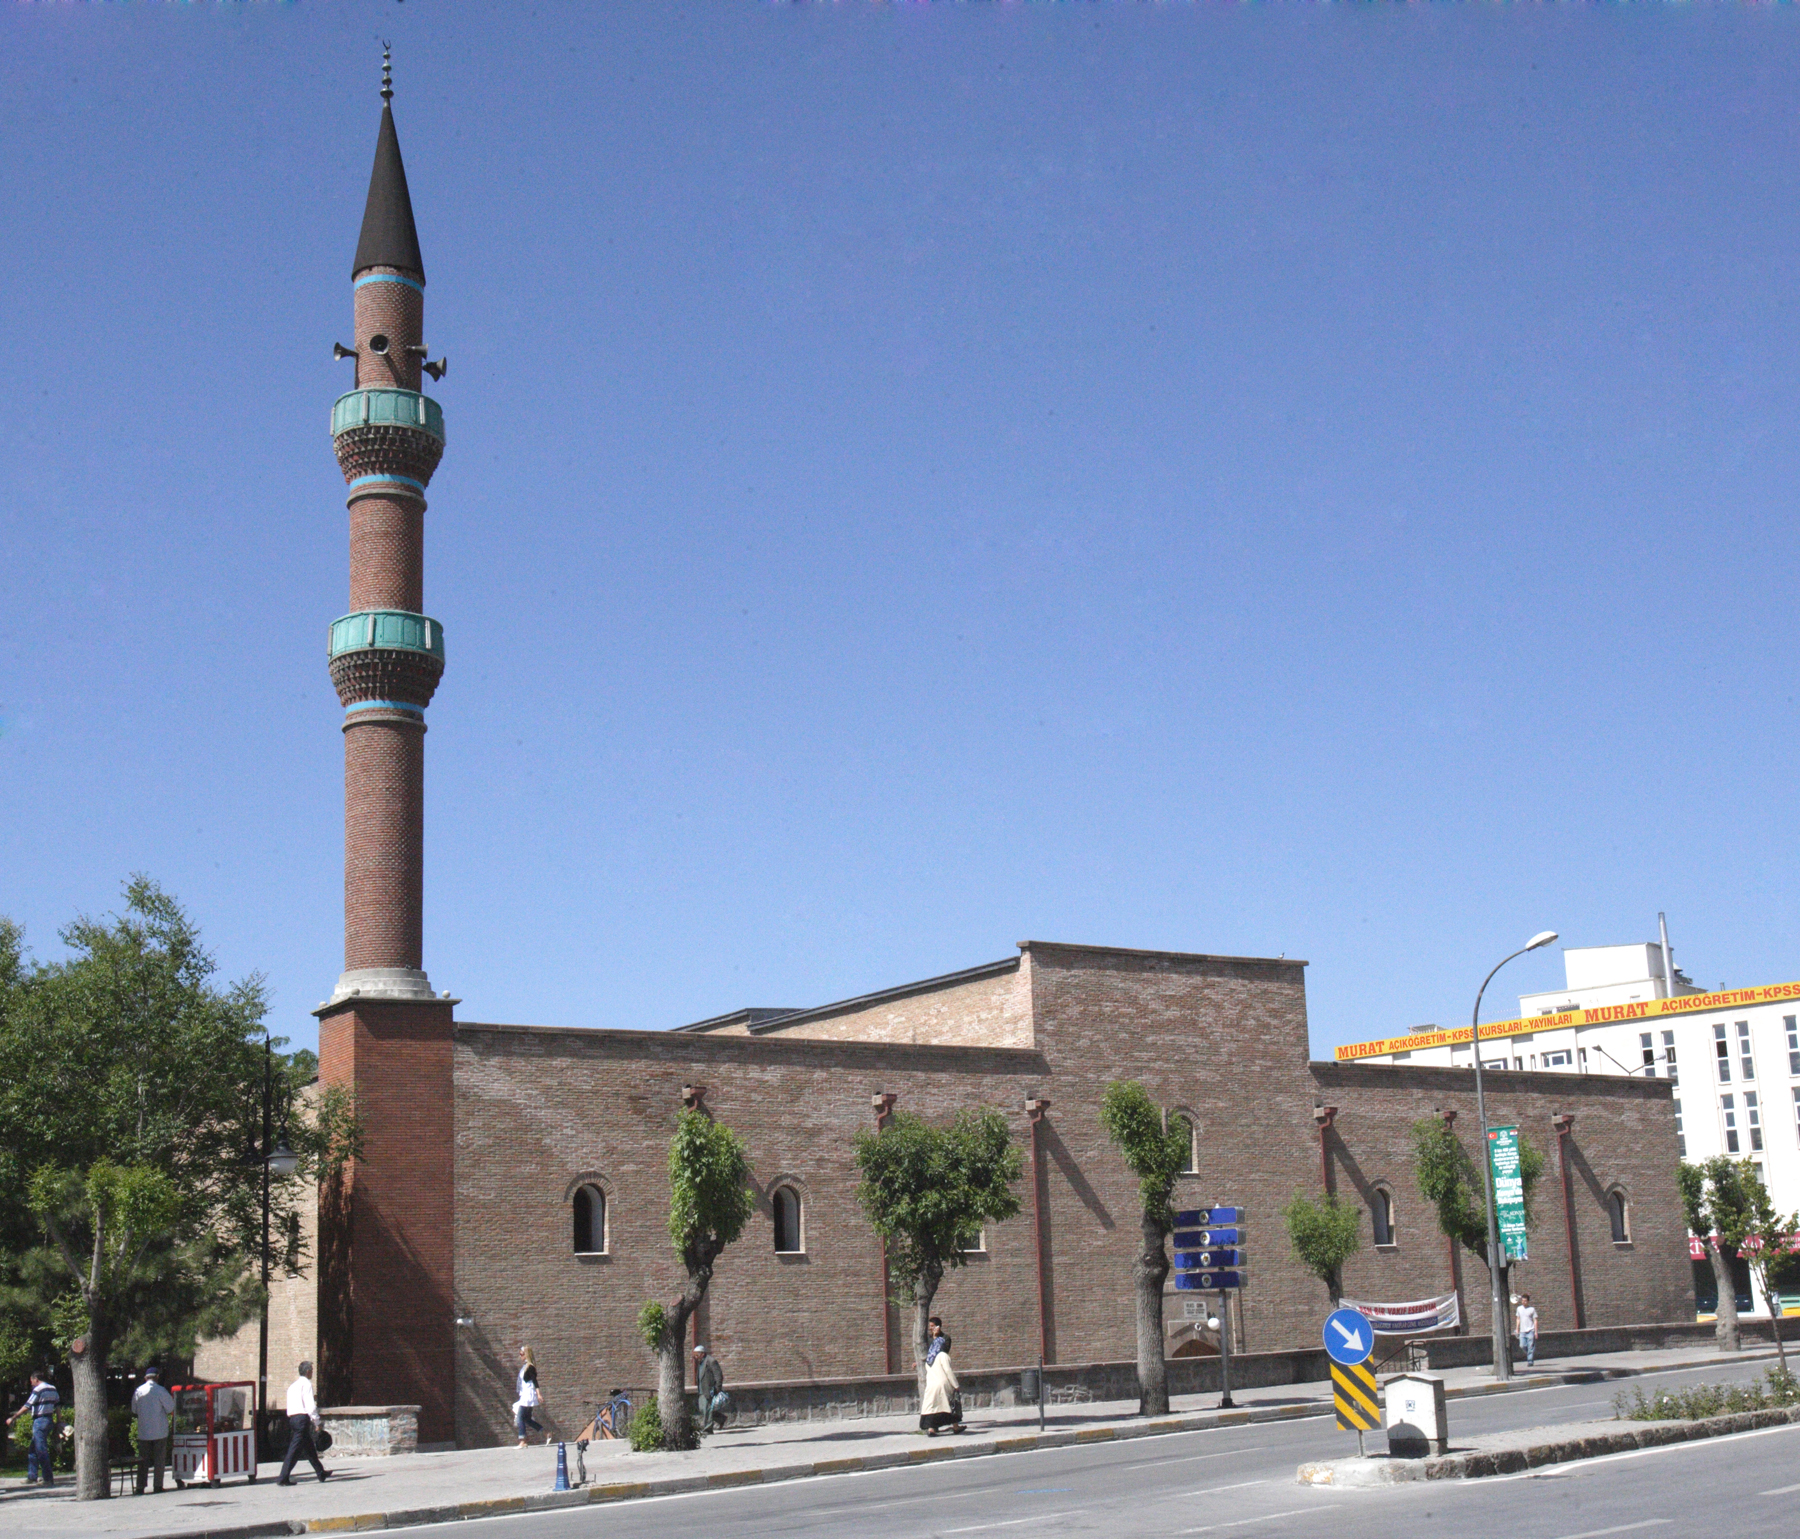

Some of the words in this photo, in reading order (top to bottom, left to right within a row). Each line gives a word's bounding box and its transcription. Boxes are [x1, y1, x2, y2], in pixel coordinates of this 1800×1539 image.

[1584, 1002, 1649, 1023] MURAT
[1337, 1040, 1385, 1059] MURAT
[1496, 1176, 1522, 1189] Dünya
[1374, 1304, 1386, 1315] BİR
[1387, 1307, 1407, 1315] VAKIF
